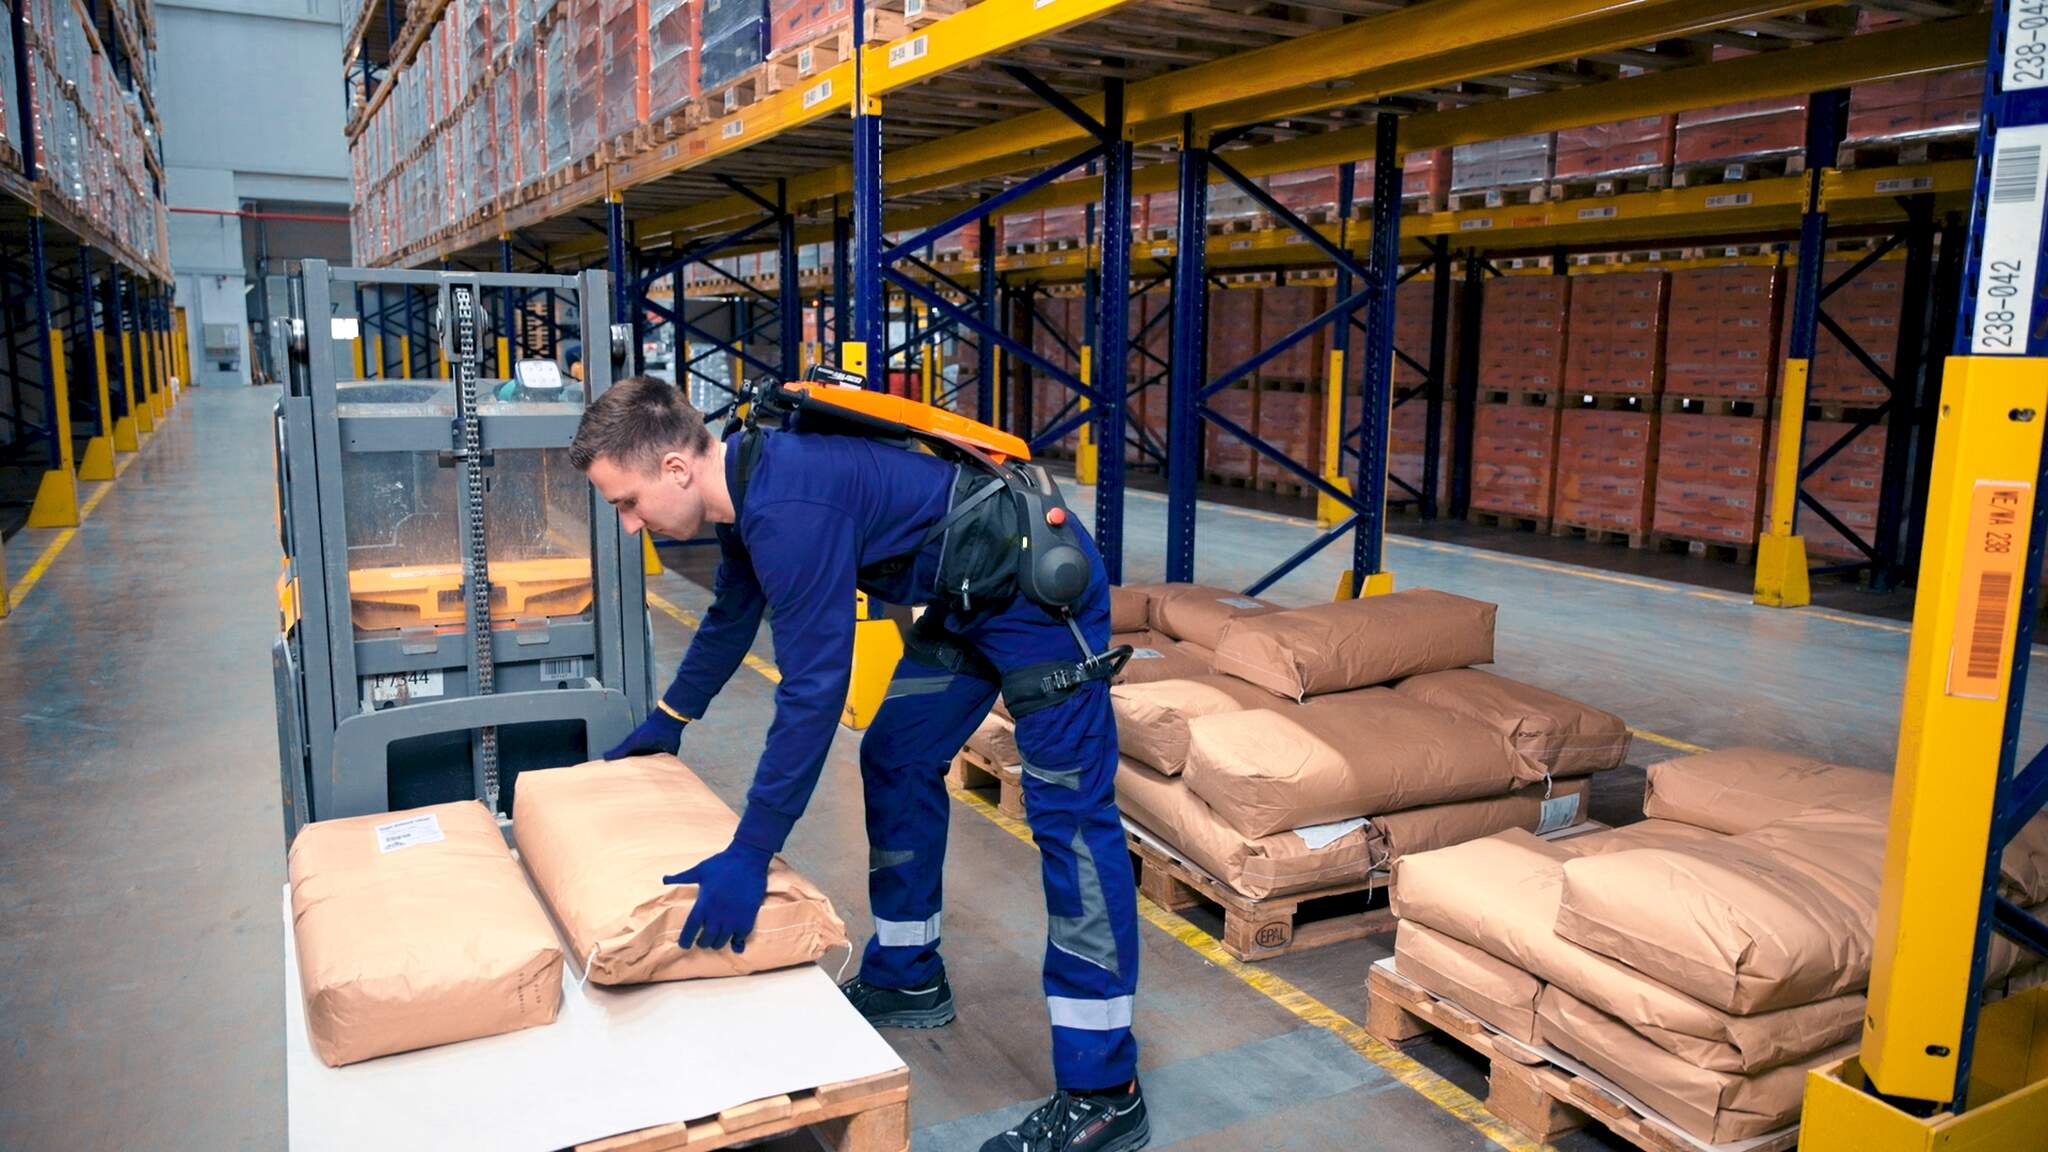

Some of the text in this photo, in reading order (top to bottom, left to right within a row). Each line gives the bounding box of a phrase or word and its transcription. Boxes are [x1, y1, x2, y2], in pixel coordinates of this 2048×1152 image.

[2012, 0, 2048, 82] 238-04
[1981, 259, 2022, 348] 238-042
[1984, 531, 2012, 554] 238
[1260, 927, 1286, 944] EPAL
